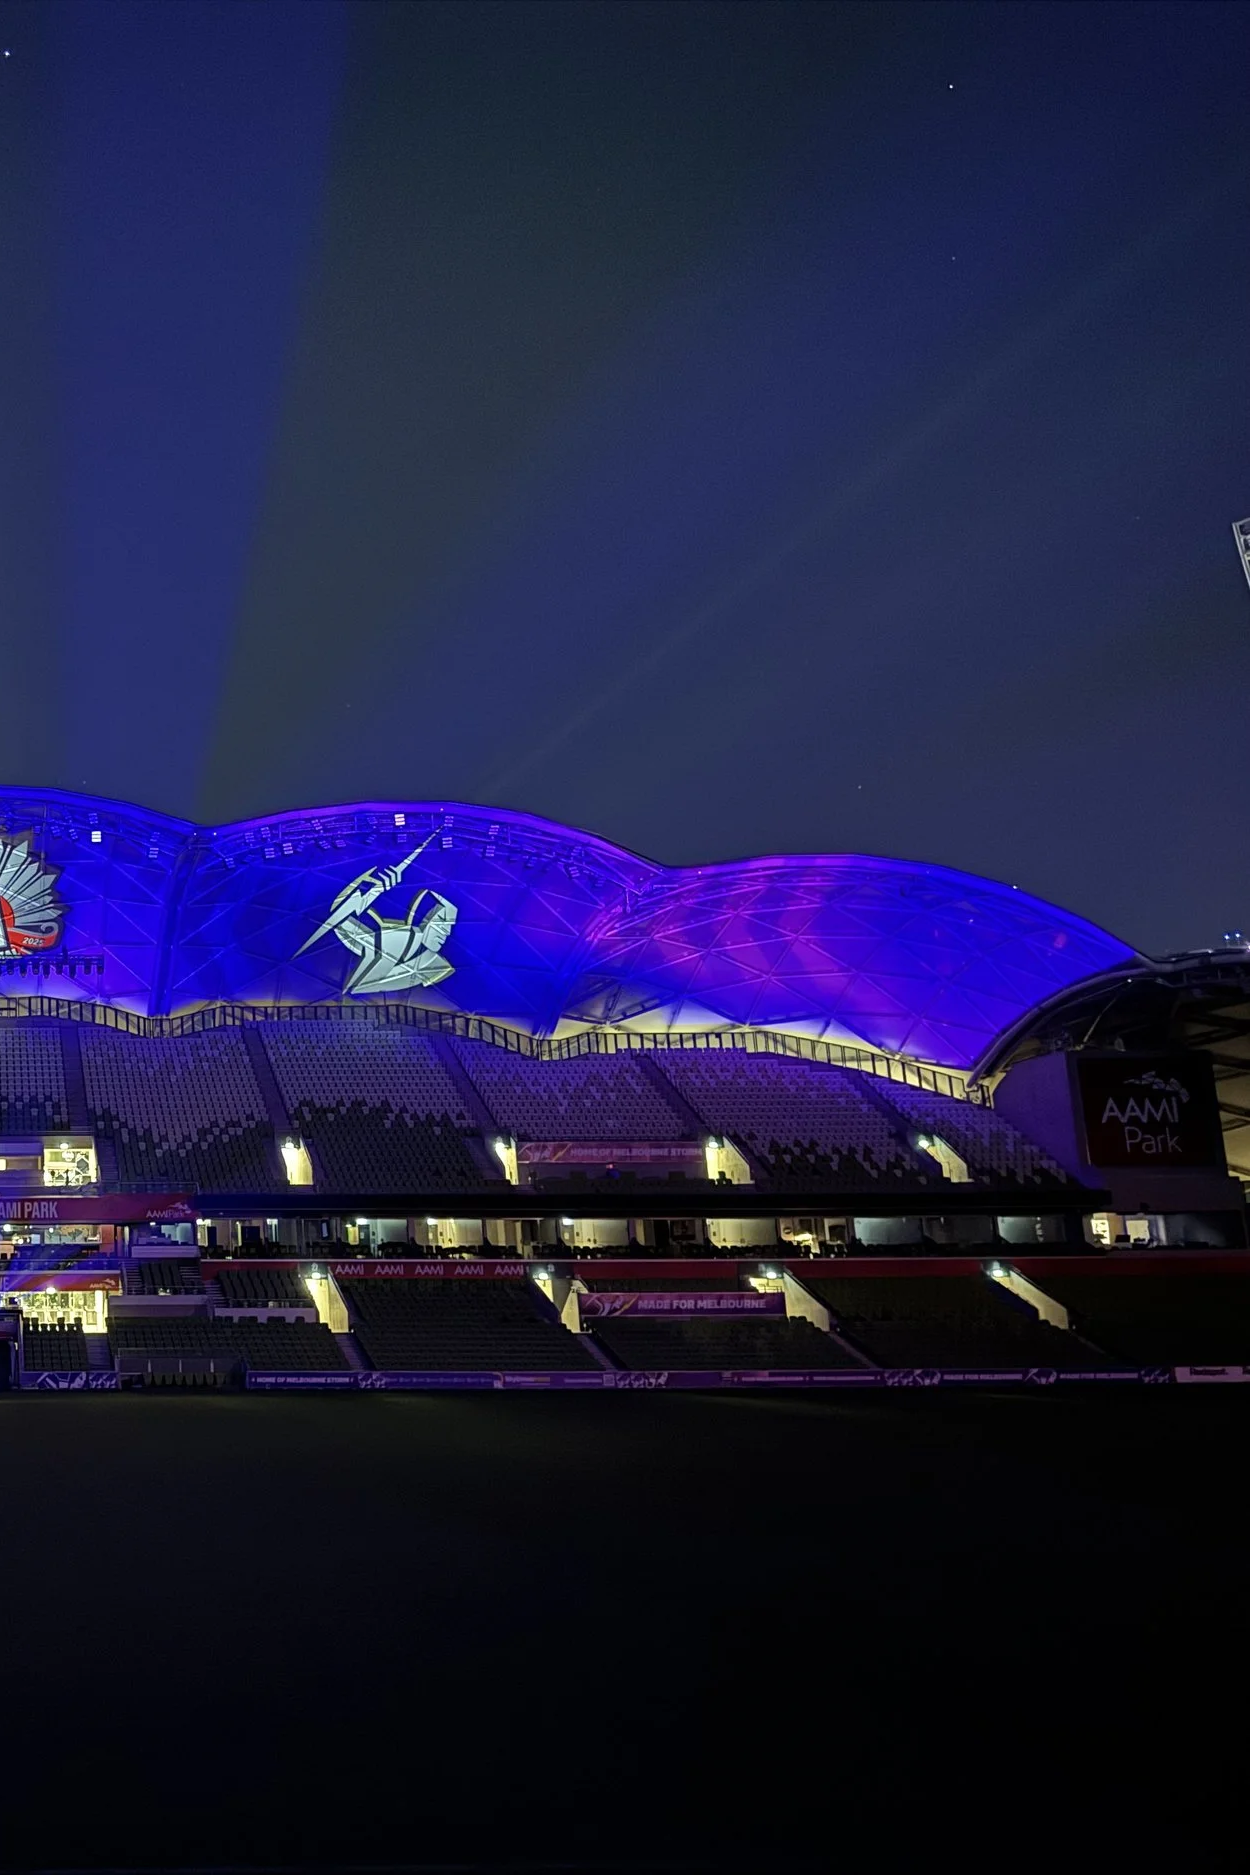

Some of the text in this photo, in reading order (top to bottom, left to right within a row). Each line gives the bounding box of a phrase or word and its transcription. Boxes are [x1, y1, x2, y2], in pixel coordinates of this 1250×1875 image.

[22, 937, 45, 946] 2025
[1102, 1096, 1179, 1124] AAMI
[1124, 1125, 1182, 1154] Park
[24, 1201, 58, 1218] PARK
[335, 1264, 524, 1275] AAMI AAMI AAMI AAMI AAMI
[638, 1299, 766, 1309] MADE FOR MELBOURNE
